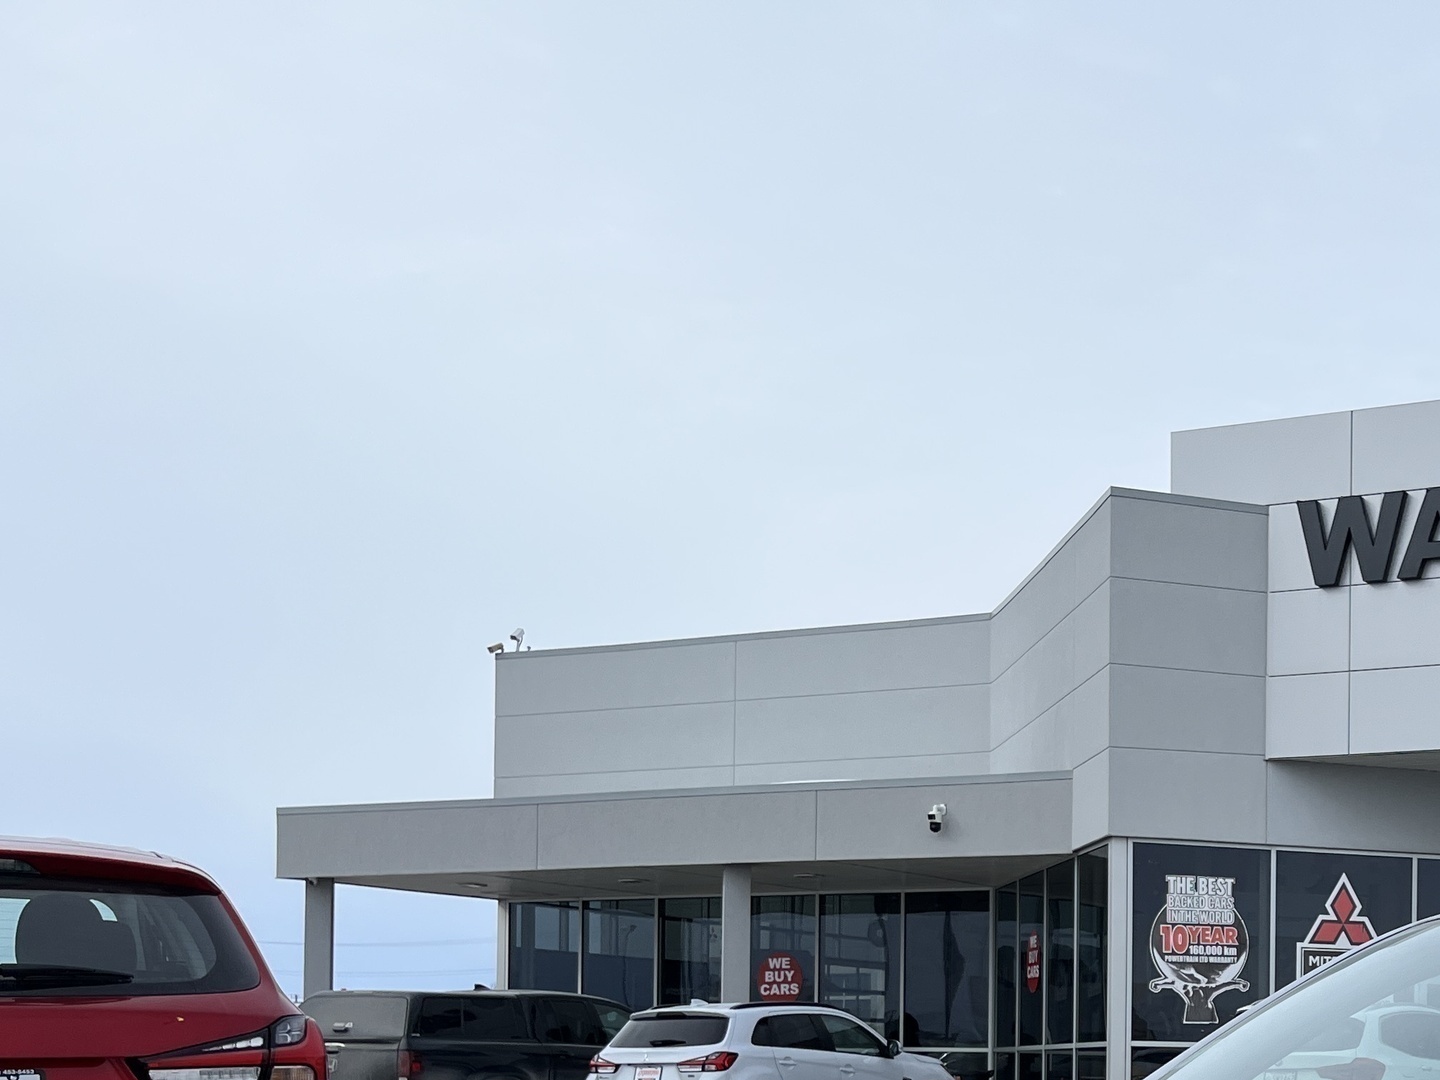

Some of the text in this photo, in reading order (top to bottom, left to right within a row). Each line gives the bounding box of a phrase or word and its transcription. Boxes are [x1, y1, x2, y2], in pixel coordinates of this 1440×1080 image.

[1166, 876, 1236, 897] THE BEST
[1168, 895, 1235, 910] BACKED CARS
[1167, 909, 1235, 924] IN THE WORLD
[1029, 935, 1038, 948] WE
[1160, 924, 1239, 954] 10 YEAR
[1028, 950, 1039, 964] BUY
[1223, 945, 1237, 956] km
[768, 957, 791, 969] WE
[764, 970, 795, 982] BUY
[1027, 964, 1040, 978] CARS
[760, 983, 800, 996] CARS
